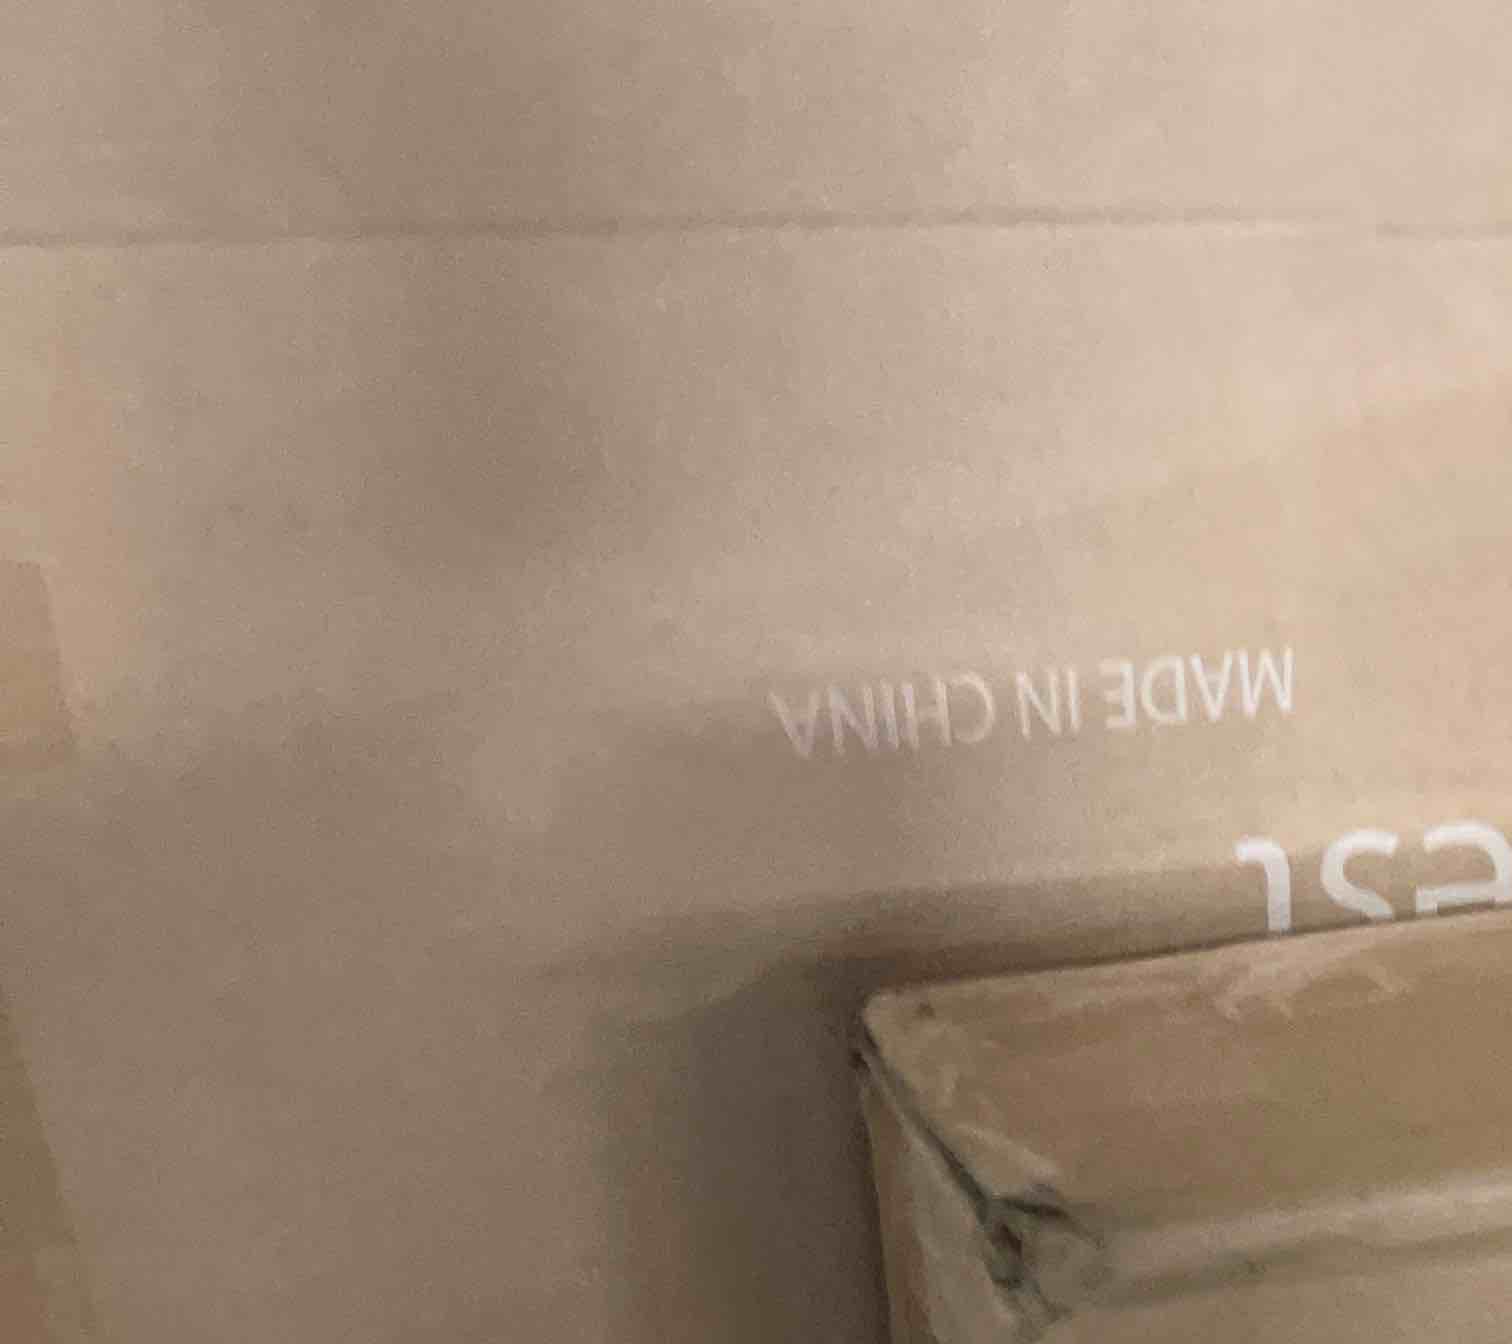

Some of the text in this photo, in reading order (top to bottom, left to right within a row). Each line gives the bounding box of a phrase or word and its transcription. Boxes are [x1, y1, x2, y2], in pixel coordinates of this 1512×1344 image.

[767, 646, 1297, 760] MADE IN CHINA
